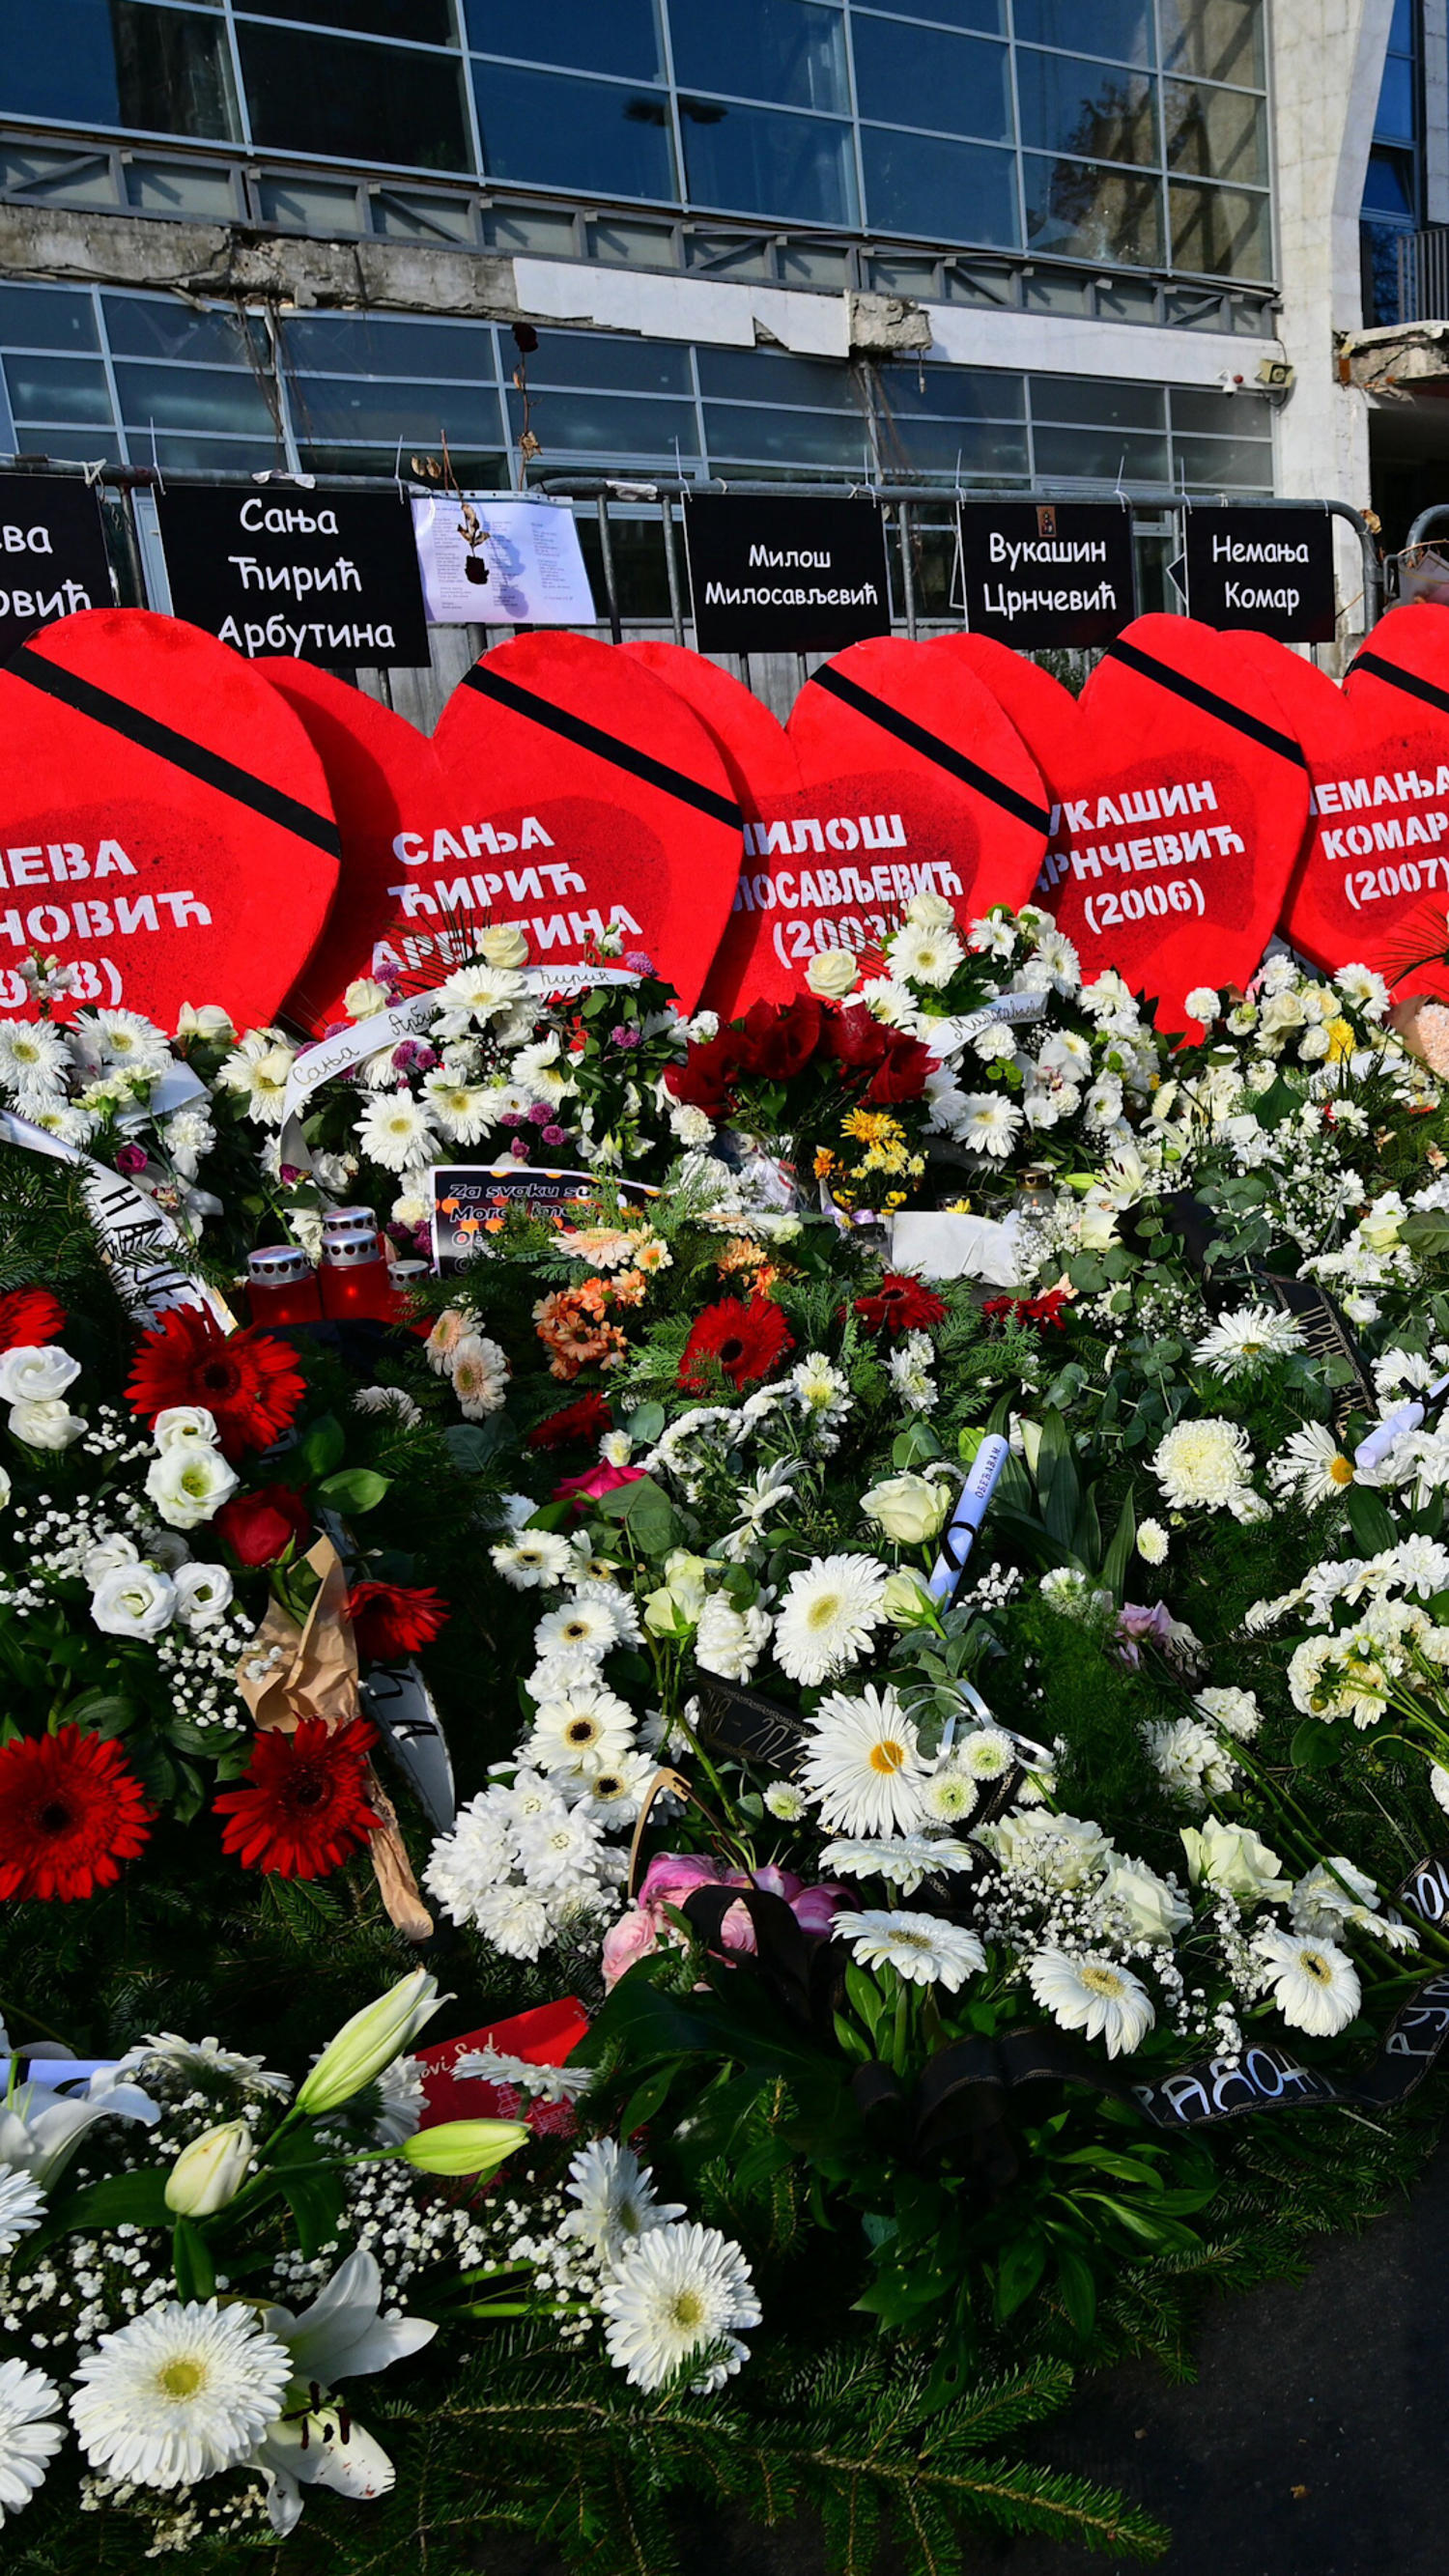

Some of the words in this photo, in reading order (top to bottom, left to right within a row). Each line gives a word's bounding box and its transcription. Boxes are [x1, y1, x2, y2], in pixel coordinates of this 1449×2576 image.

[240, 497, 339, 535] Сања
[0, 524, 53, 554] ва
[749, 544, 831, 568] Милош
[989, 531, 1106, 572] Вукашин
[1212, 534, 1310, 563] Немања
[227, 555, 362, 602] Ћирић
[705, 581, 878, 607] Милосављевић
[1225, 580, 1300, 616] Комар
[983, 580, 1117, 621] Црнчевић
[217, 613, 396, 657] Арбутина
[1309, 765, 1449, 816] ЕМАЊА
[392, 816, 554, 865] САЊА
[743, 814, 907, 856] ИЛОШ
[1321, 812, 1449, 861] КОМАР
[0, 839, 138, 889] ЕВА
[1036, 825, 1245, 892] РНЧЕВИЋ
[387, 863, 586, 918] ЋИРИЋ
[1084, 878, 1206, 935] (2006)
[294, 1045, 360, 1086] Сања
[448, 1183, 481, 1200] Za
[486, 1182, 559, 1199] svaku
[420, 2055, 452, 2079] ovi
